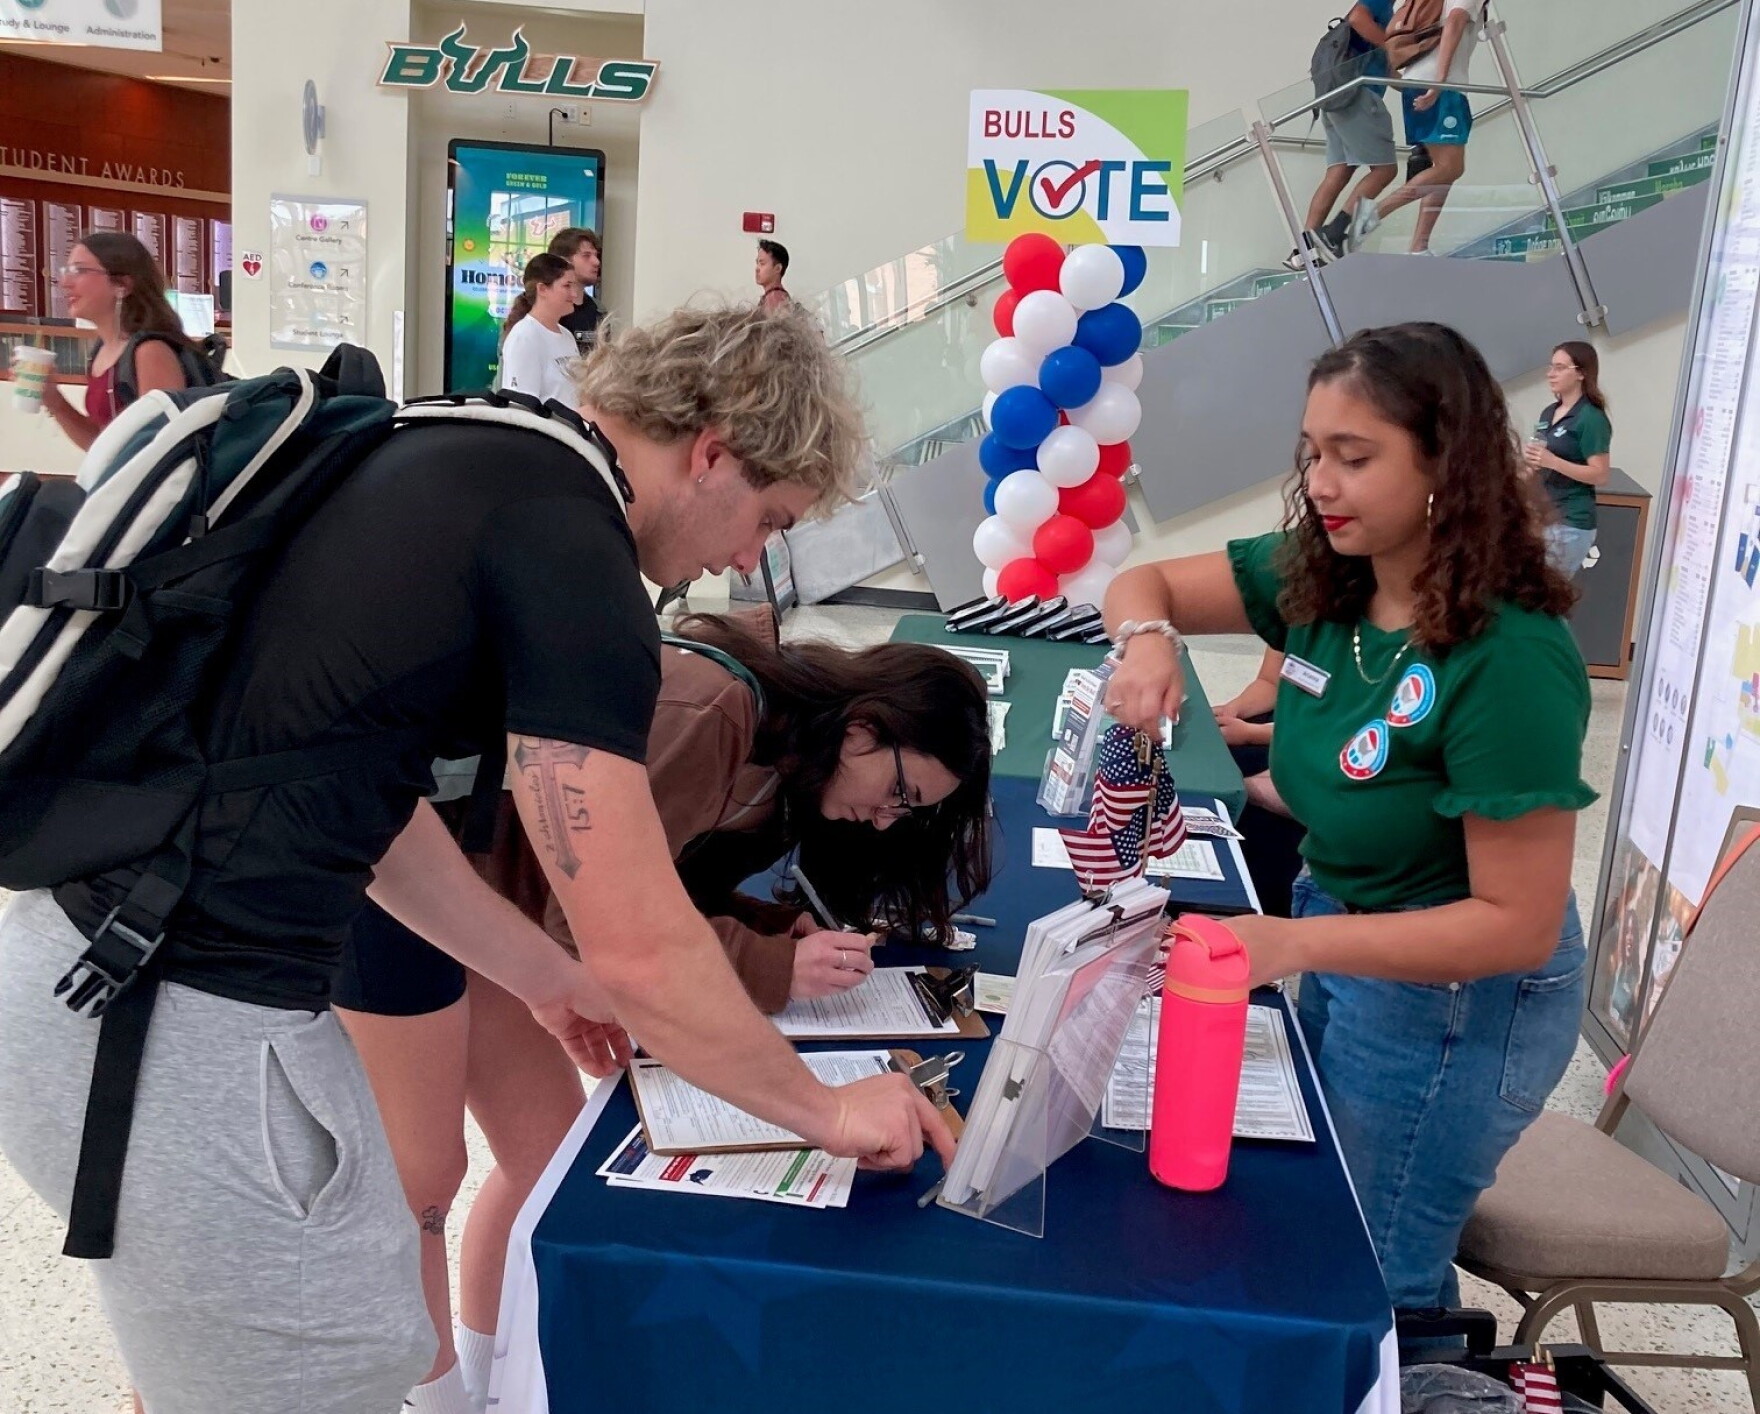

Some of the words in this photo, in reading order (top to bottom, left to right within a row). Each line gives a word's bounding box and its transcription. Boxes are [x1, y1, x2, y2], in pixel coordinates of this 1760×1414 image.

[0, 19, 19, 30] udy
[23, 19, 30, 29] &
[34, 21, 70, 33] Lounge
[86, 25, 156, 41] Administration
[378, 20, 660, 101] BULLS
[984, 110, 1075, 139] BULLS
[0, 146, 89, 176] TUDENT
[102, 161, 186, 189] AWARDS
[983, 159, 1172, 221] VOTE
[461, 269, 525, 287] Homec
[562, 783, 592, 831] 15:7
